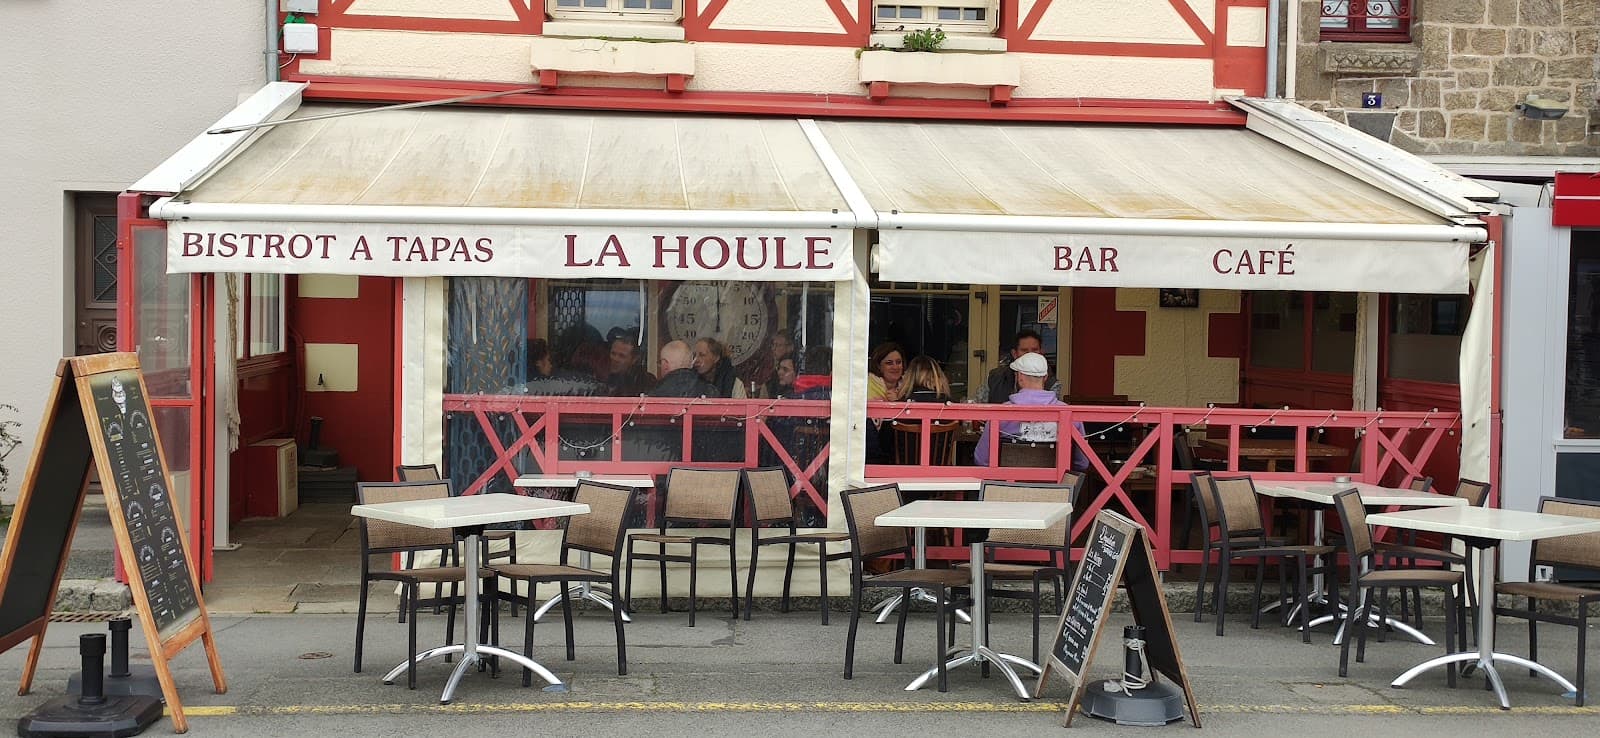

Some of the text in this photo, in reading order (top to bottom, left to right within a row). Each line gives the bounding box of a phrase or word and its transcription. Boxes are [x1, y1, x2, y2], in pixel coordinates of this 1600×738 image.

[1368, 95, 1376, 105] 3
[182, 233, 495, 264] BISTROT A TAPAS
[564, 233, 834, 270] LA HOULE
[1053, 246, 1119, 272] BAR
[1212, 244, 1295, 275] CAFÉ
[743, 313, 759, 325] 15
